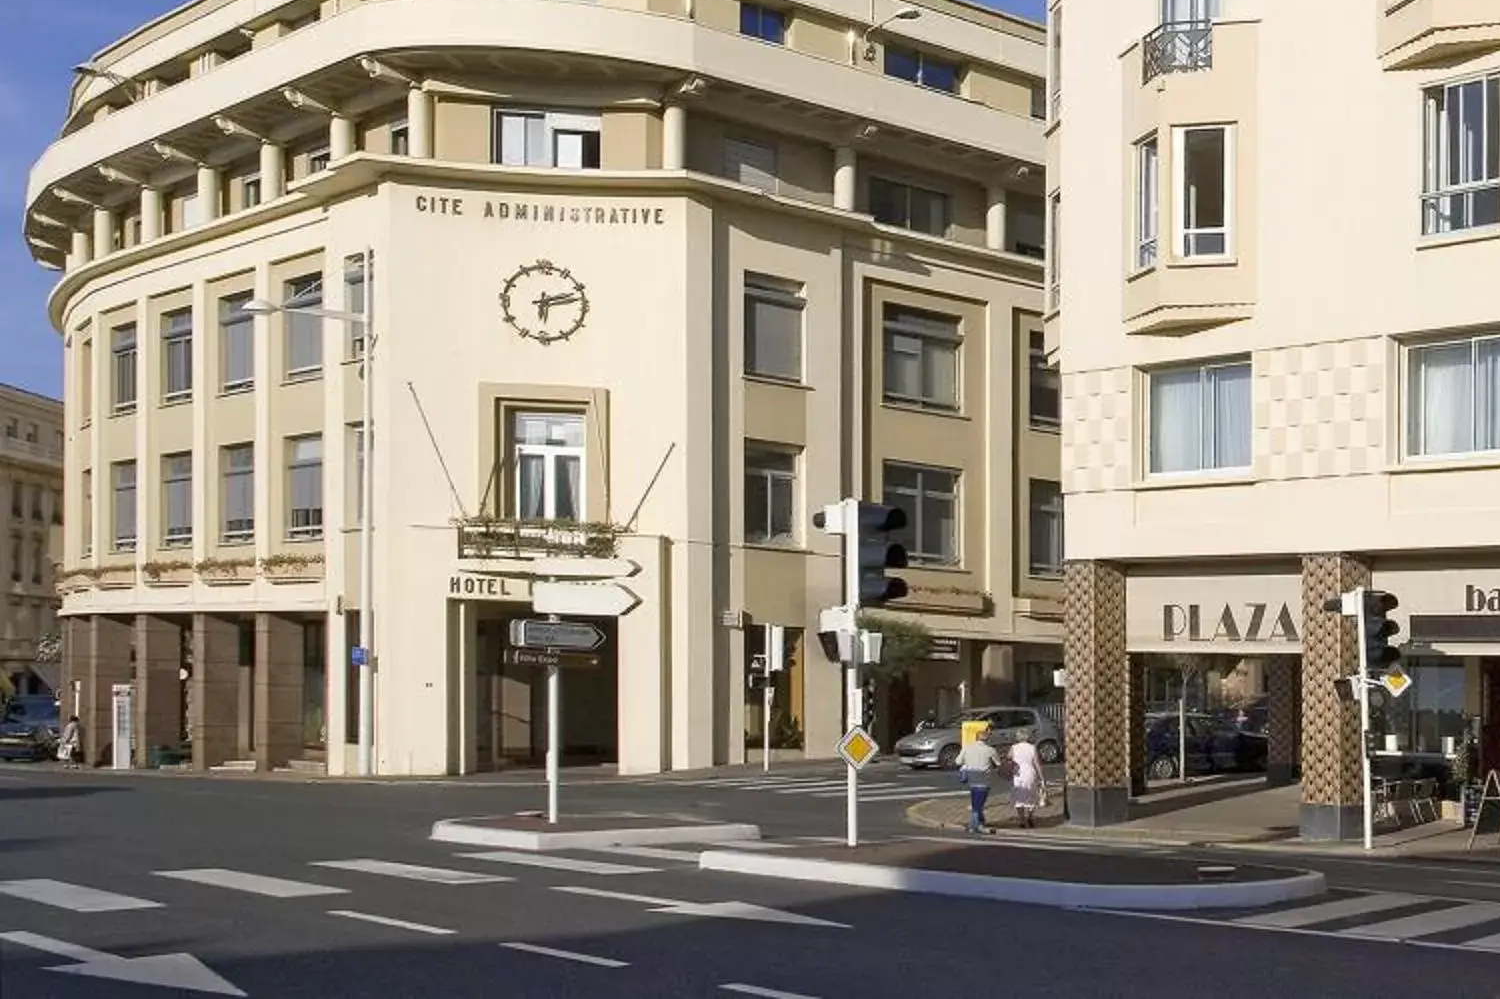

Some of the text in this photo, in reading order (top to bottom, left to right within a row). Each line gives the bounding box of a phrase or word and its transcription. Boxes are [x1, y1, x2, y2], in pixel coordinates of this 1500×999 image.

[416, 196, 665, 224] CITE ADMINISTRATIVE
[450, 576, 511, 596] HOTEL
[1163, 602, 1300, 642] PLAZA
